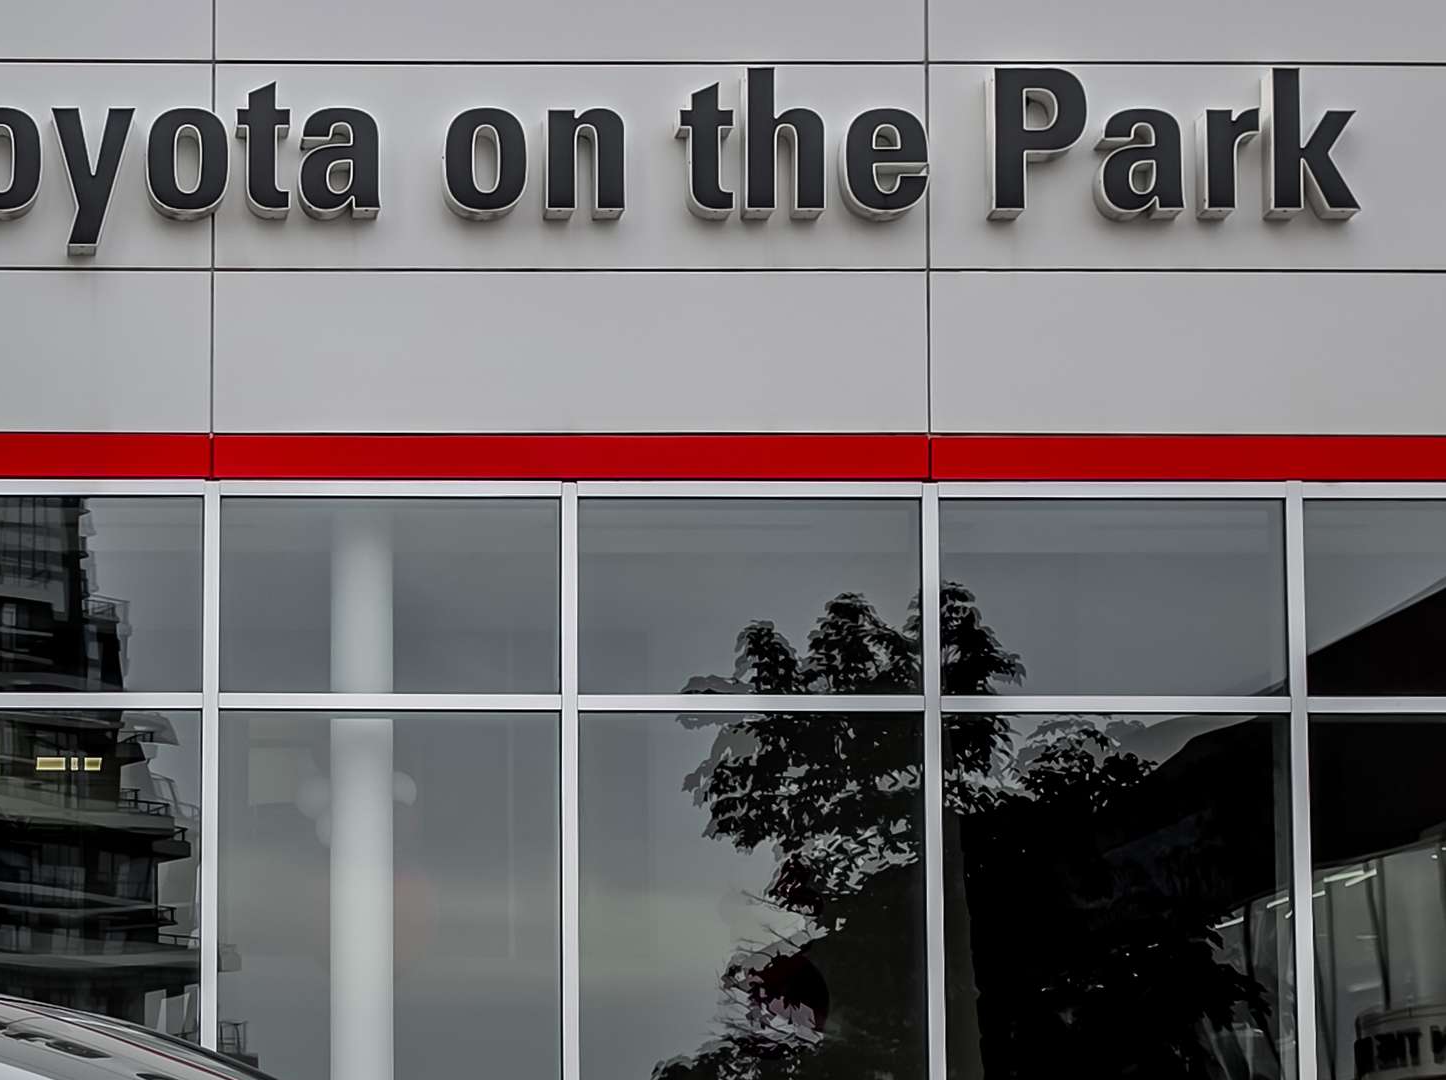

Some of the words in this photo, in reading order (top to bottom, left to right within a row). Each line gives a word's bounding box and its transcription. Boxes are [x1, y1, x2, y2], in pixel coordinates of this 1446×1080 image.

[443, 107, 626, 220] on
[675, 66, 930, 221] the
[985, 66, 1362, 221] Park
